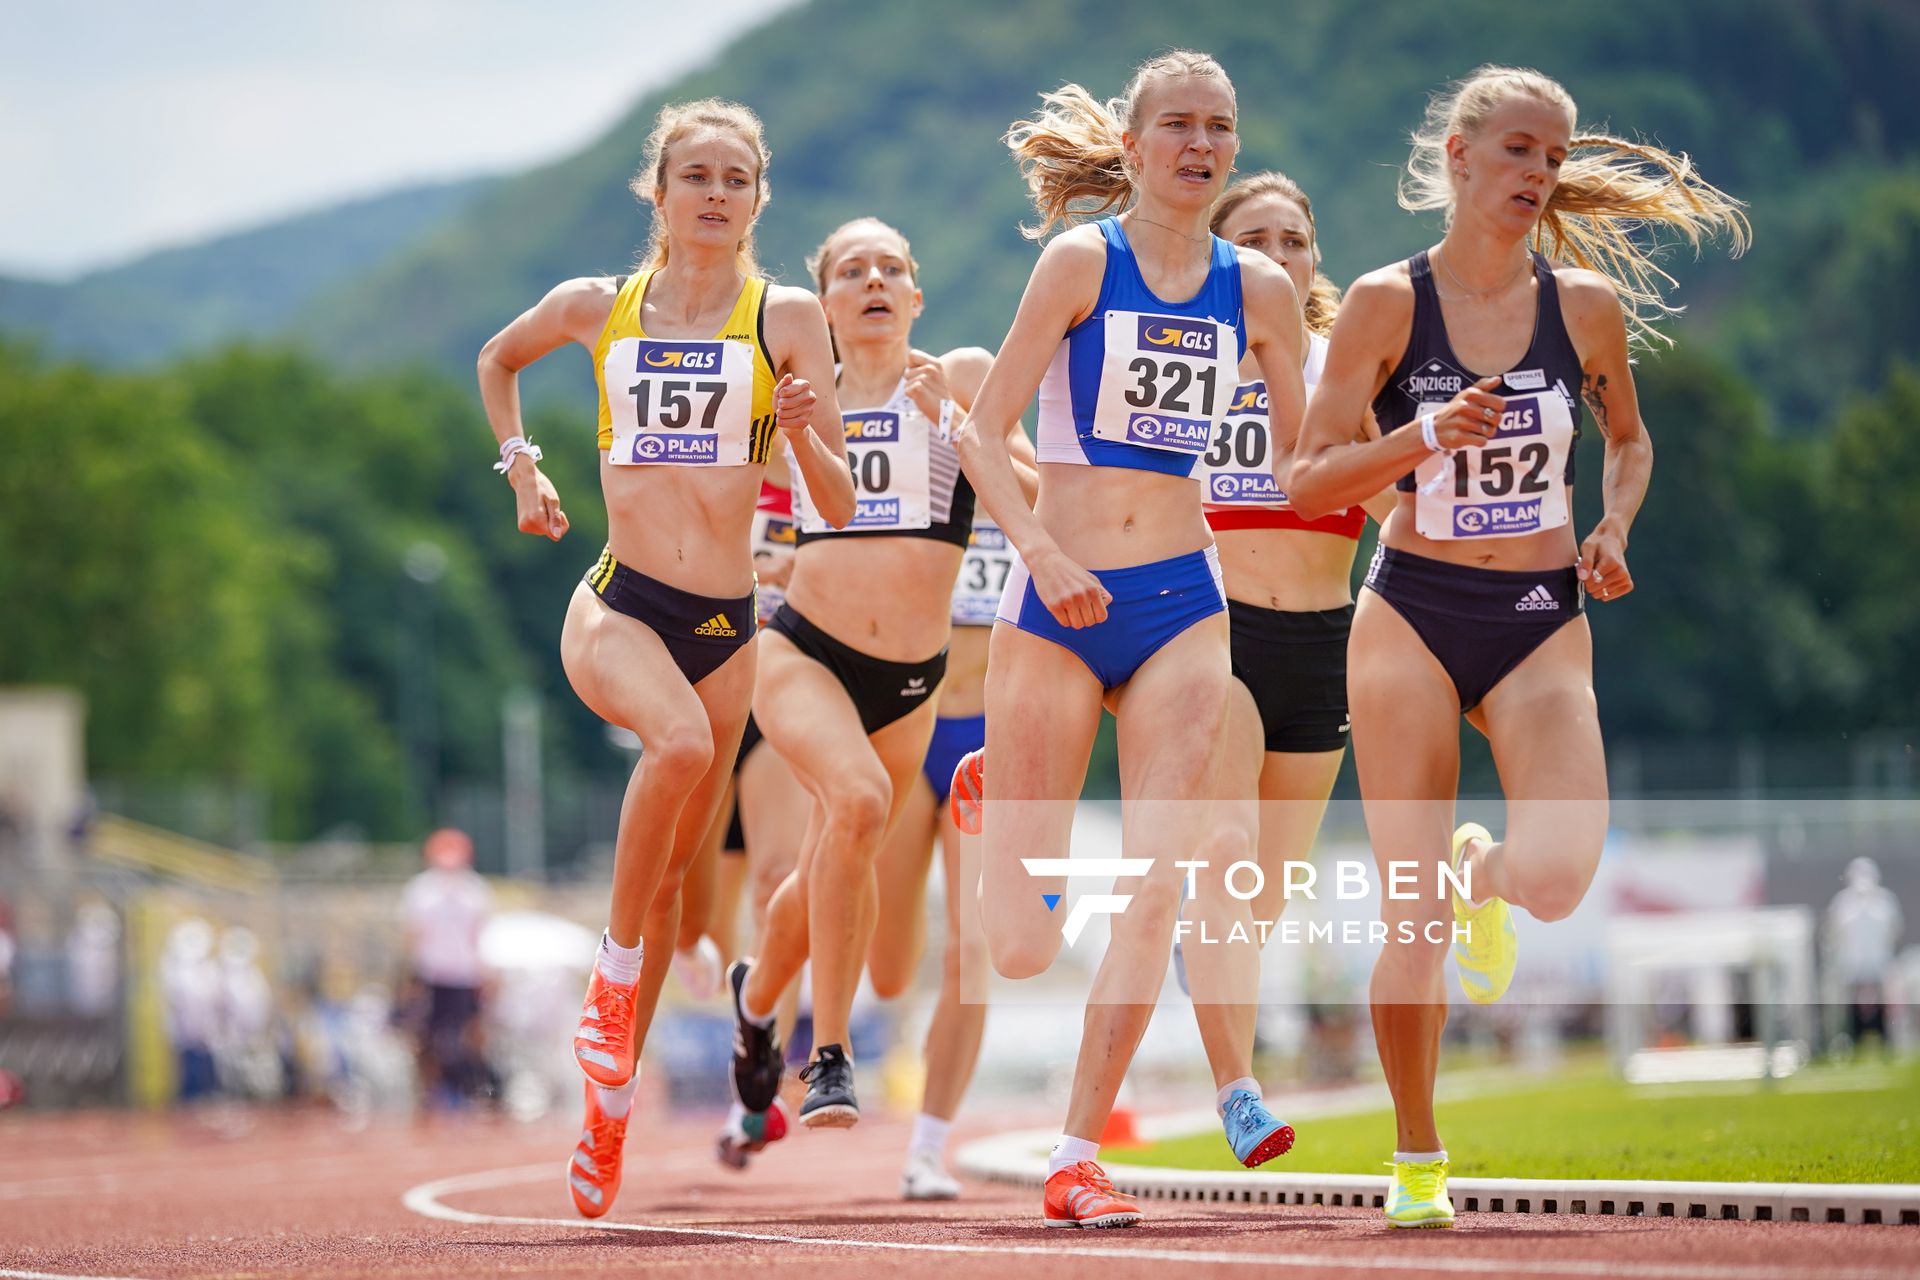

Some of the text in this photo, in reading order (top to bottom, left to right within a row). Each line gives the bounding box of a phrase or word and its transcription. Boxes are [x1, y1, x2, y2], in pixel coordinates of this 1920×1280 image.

[1181, 331, 1212, 350] GLS
[682, 352, 715, 368] GLS
[1124, 357, 1217, 416] 321
[1408, 376, 1462, 394] SINZIGER
[628, 379, 728, 429] 157
[862, 419, 894, 437] GLS
[1499, 409, 1533, 430] GLS
[1164, 421, 1209, 441] PLAN
[668, 440, 714, 452] PLAN
[1163, 437, 1205, 447] INTERNATIONAL
[1453, 442, 1550, 498] 152
[856, 503, 896, 516] PLAN
[1491, 504, 1541, 522] PLAN
[1515, 600, 1560, 611] adidas
[694, 626, 737, 637] adidas
